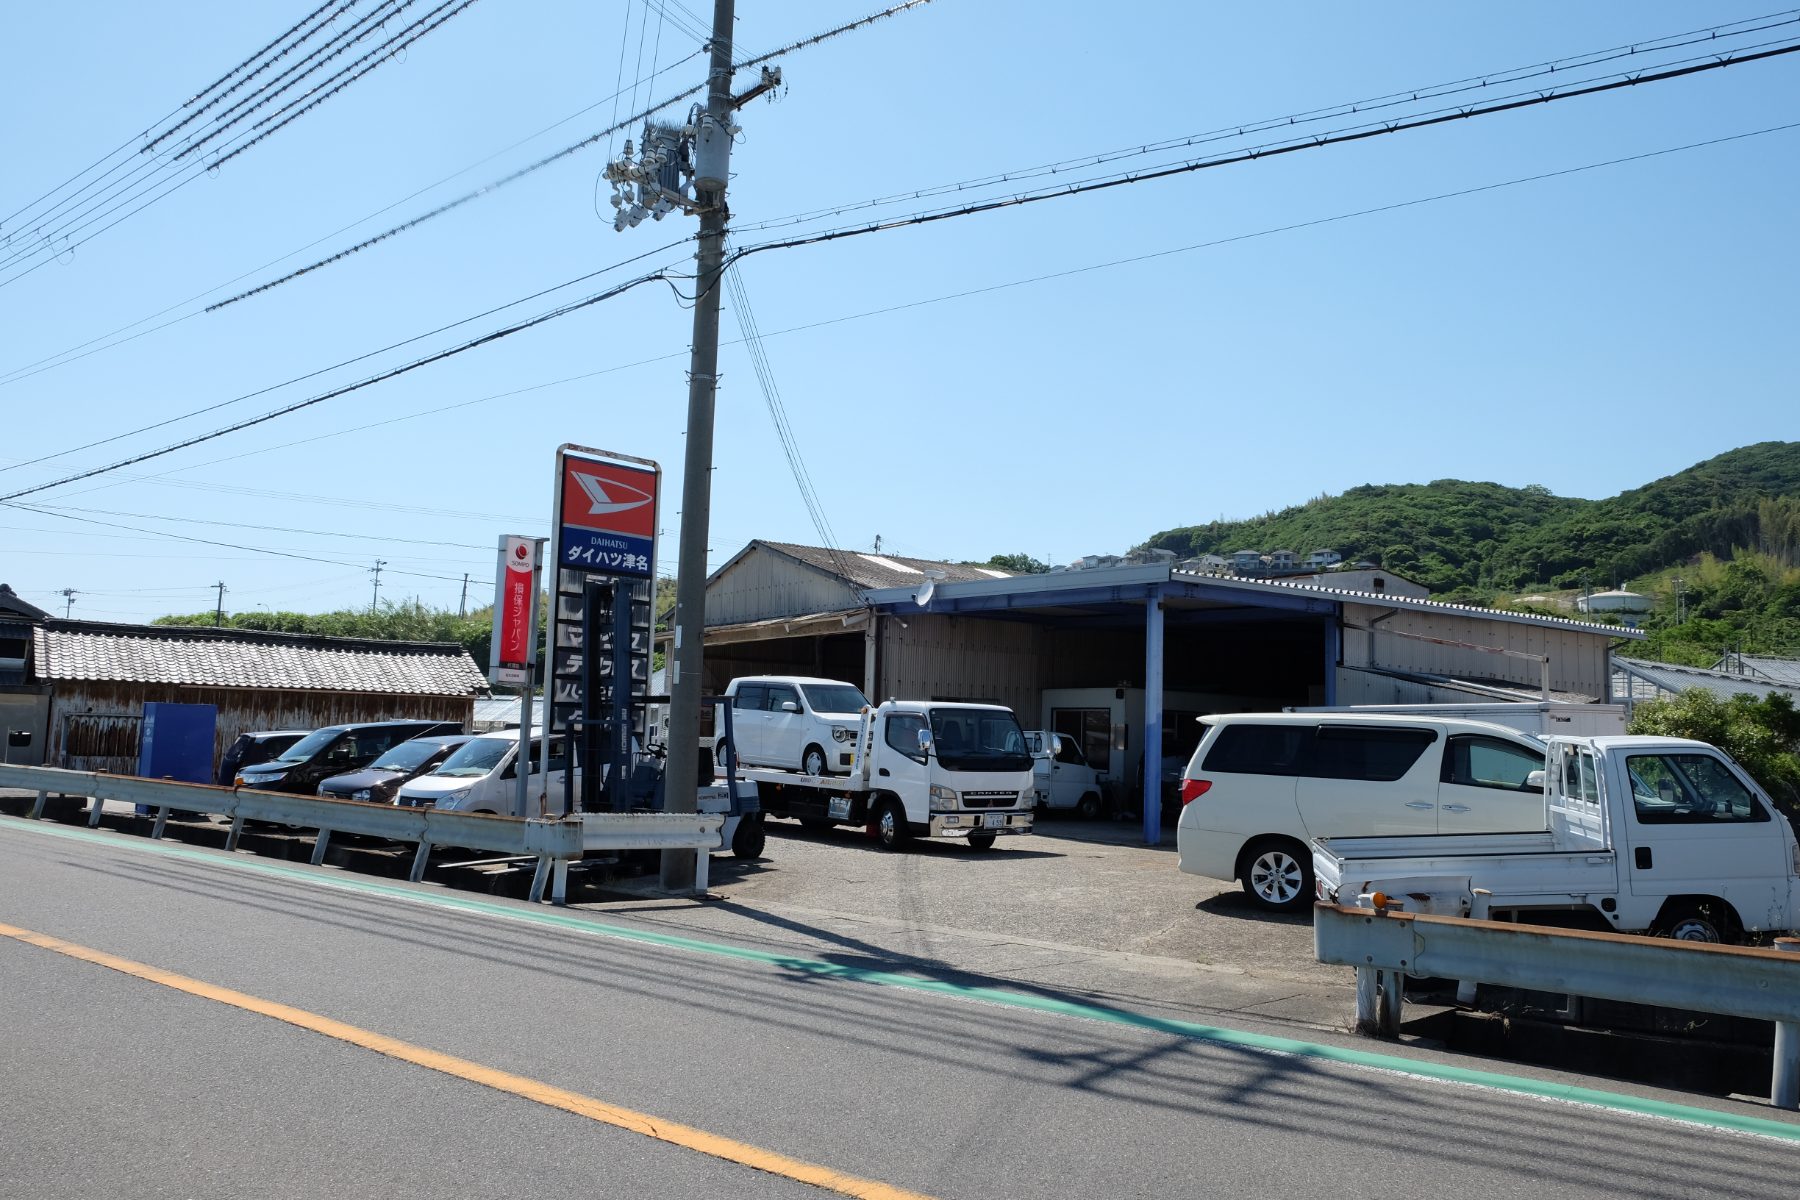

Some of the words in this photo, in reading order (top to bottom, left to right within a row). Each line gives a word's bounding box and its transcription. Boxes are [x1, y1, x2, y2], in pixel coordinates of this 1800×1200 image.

[591, 537, 628, 549] DAIHATSU
[512, 560, 530, 568] SOMPO
[568, 545, 648, 571] ダイハツ津名
[510, 582, 524, 651] 損保ジャパン
